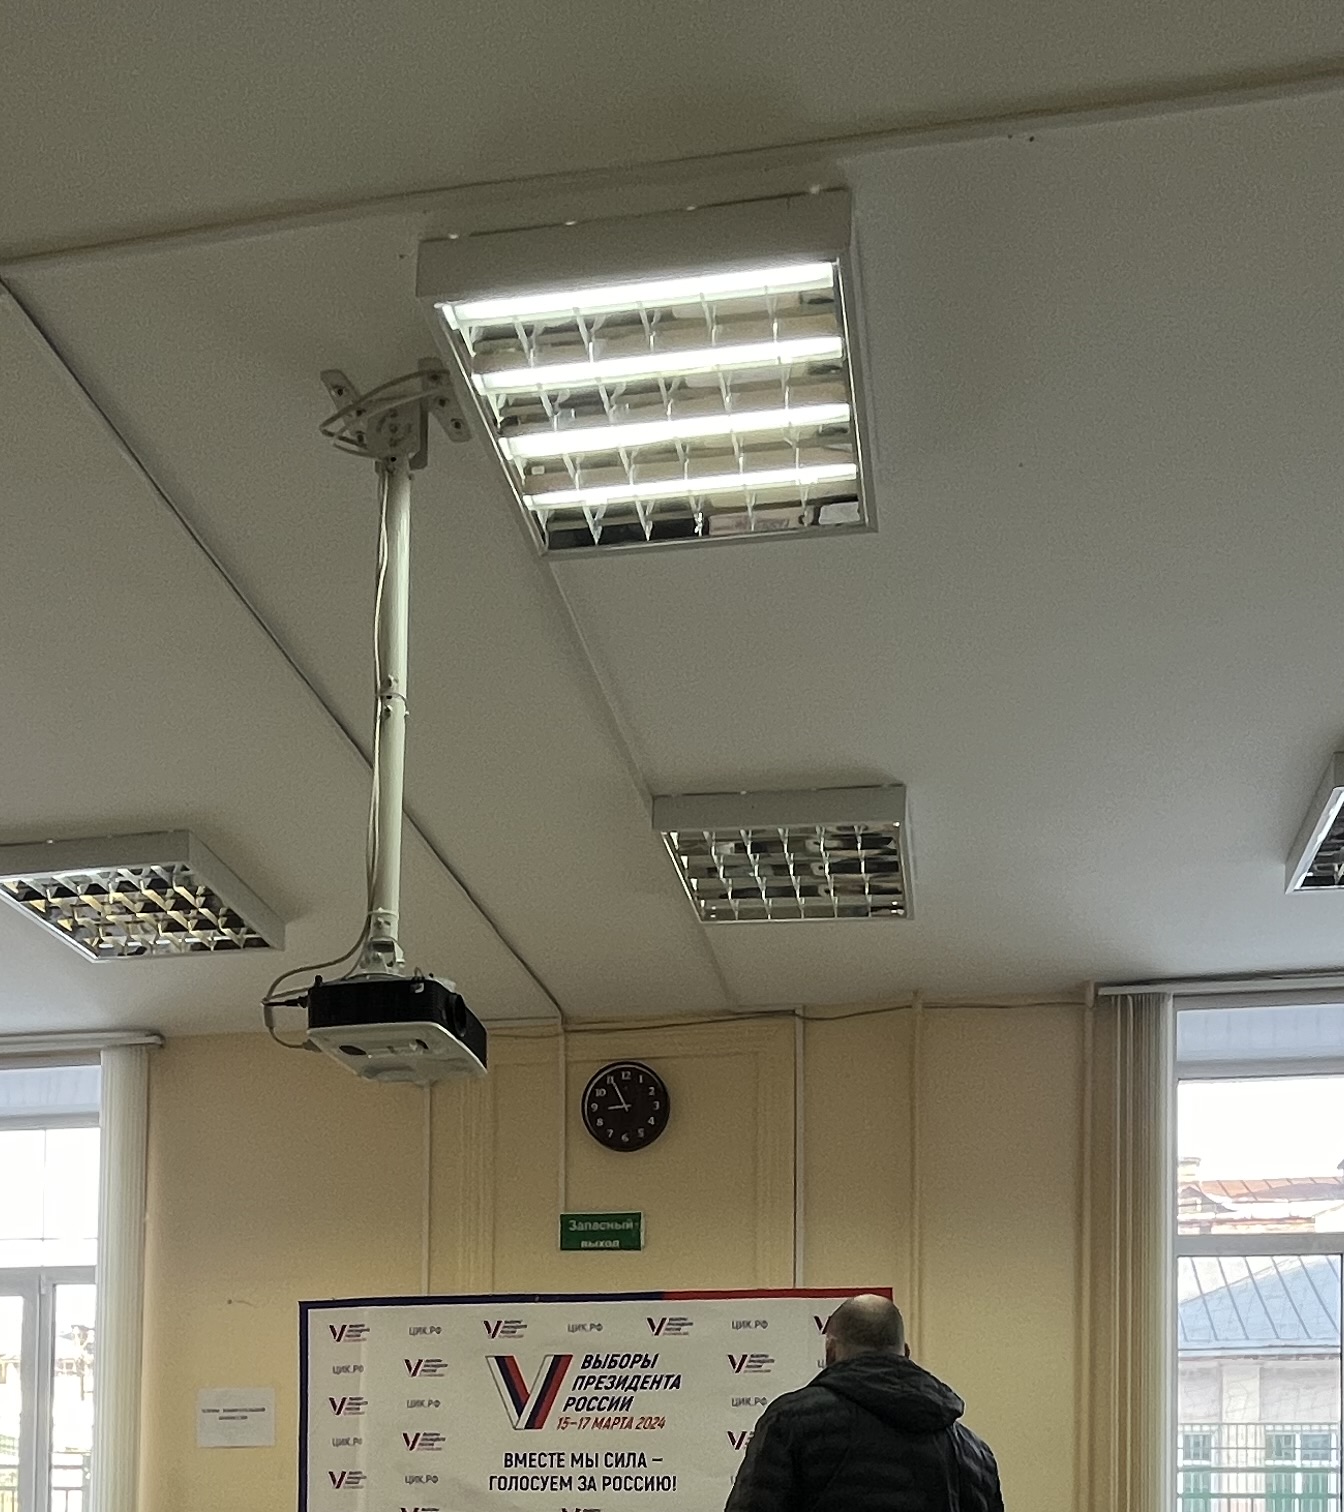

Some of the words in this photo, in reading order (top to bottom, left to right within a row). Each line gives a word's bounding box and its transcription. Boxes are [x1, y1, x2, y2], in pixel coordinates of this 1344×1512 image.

[568, 1219, 634, 1231] Запасный
[580, 1240, 620, 1248] выход
[581, 1353, 659, 1370] ВЫБОРЫ
[572, 1374, 682, 1392] ПРЕЗИДЕНТА
[562, 1396, 634, 1412] РОССИИ
[591, 1417, 634, 1430] МАРТА
[635, 1416, 666, 1430] 2024
[504, 1452, 565, 1468] ВМЕСТЕ
[571, 1452, 598, 1468] МЫ
[605, 1452, 647, 1468] СИЛА
[489, 1475, 572, 1491] ГОЛОСУЕМ
[577, 1475, 597, 1491] ЗА
[602, 1475, 677, 1492] РОССИЮ!
